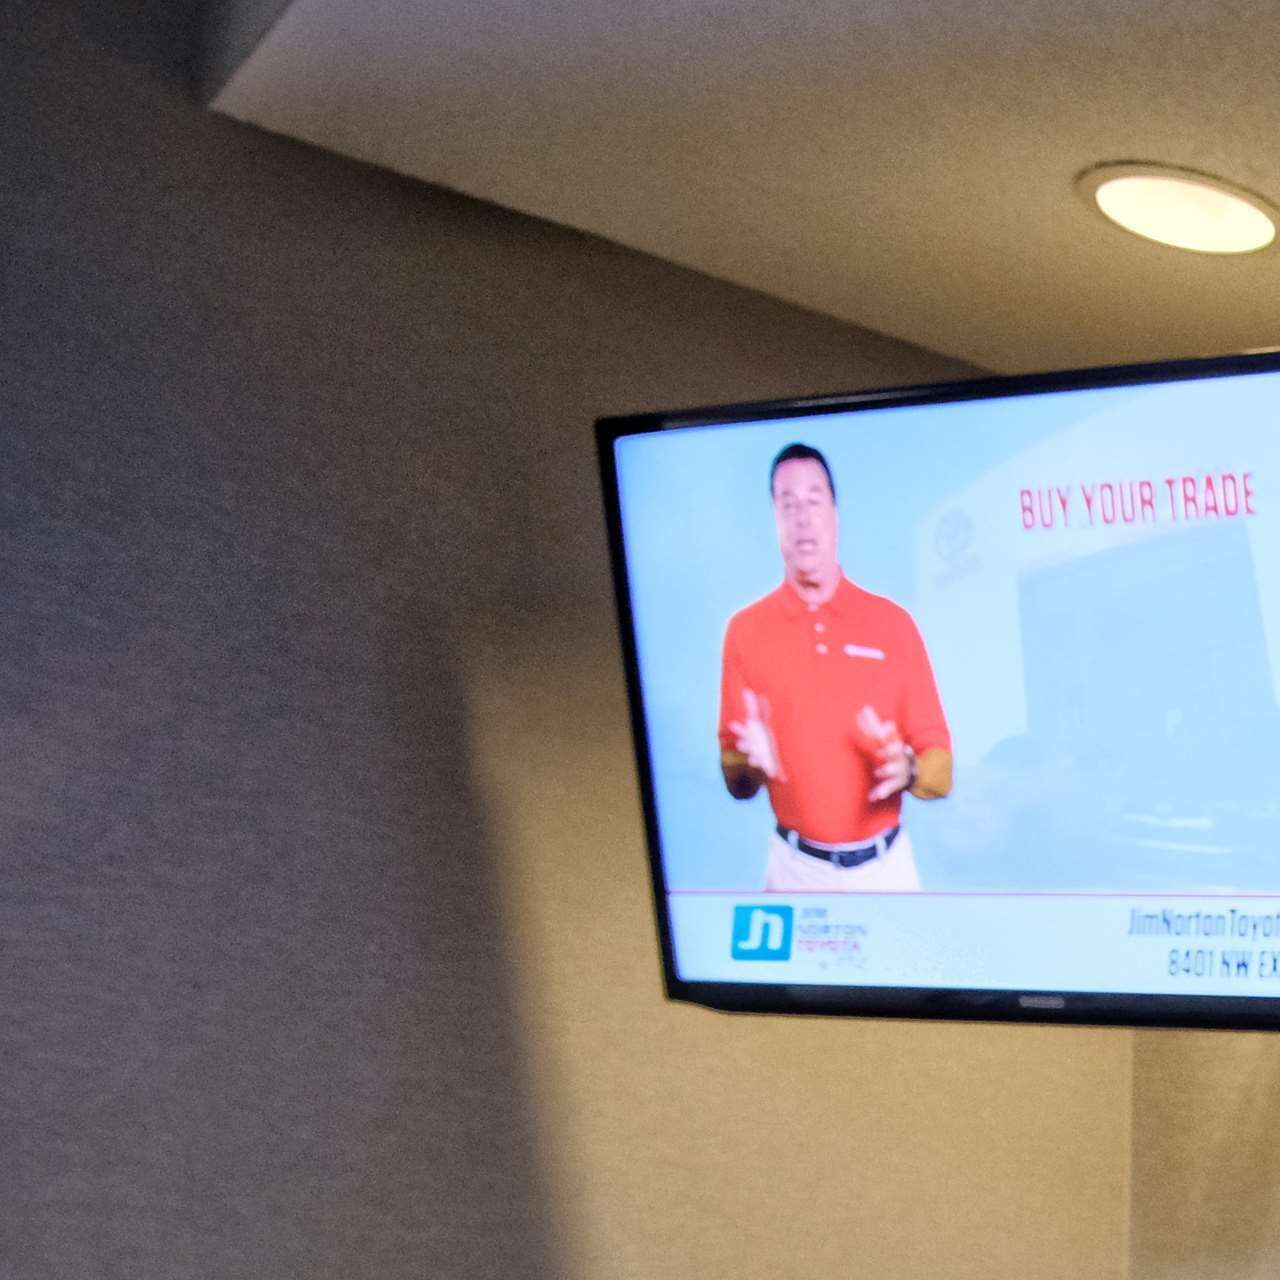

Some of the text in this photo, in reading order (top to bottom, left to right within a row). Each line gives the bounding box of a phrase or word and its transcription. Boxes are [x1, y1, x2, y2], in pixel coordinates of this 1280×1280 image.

[1019, 471, 1256, 530] BUY YOUR TRADE
[1167, 948, 1215, 977] 8401
[1220, 949, 1250, 978] NW
